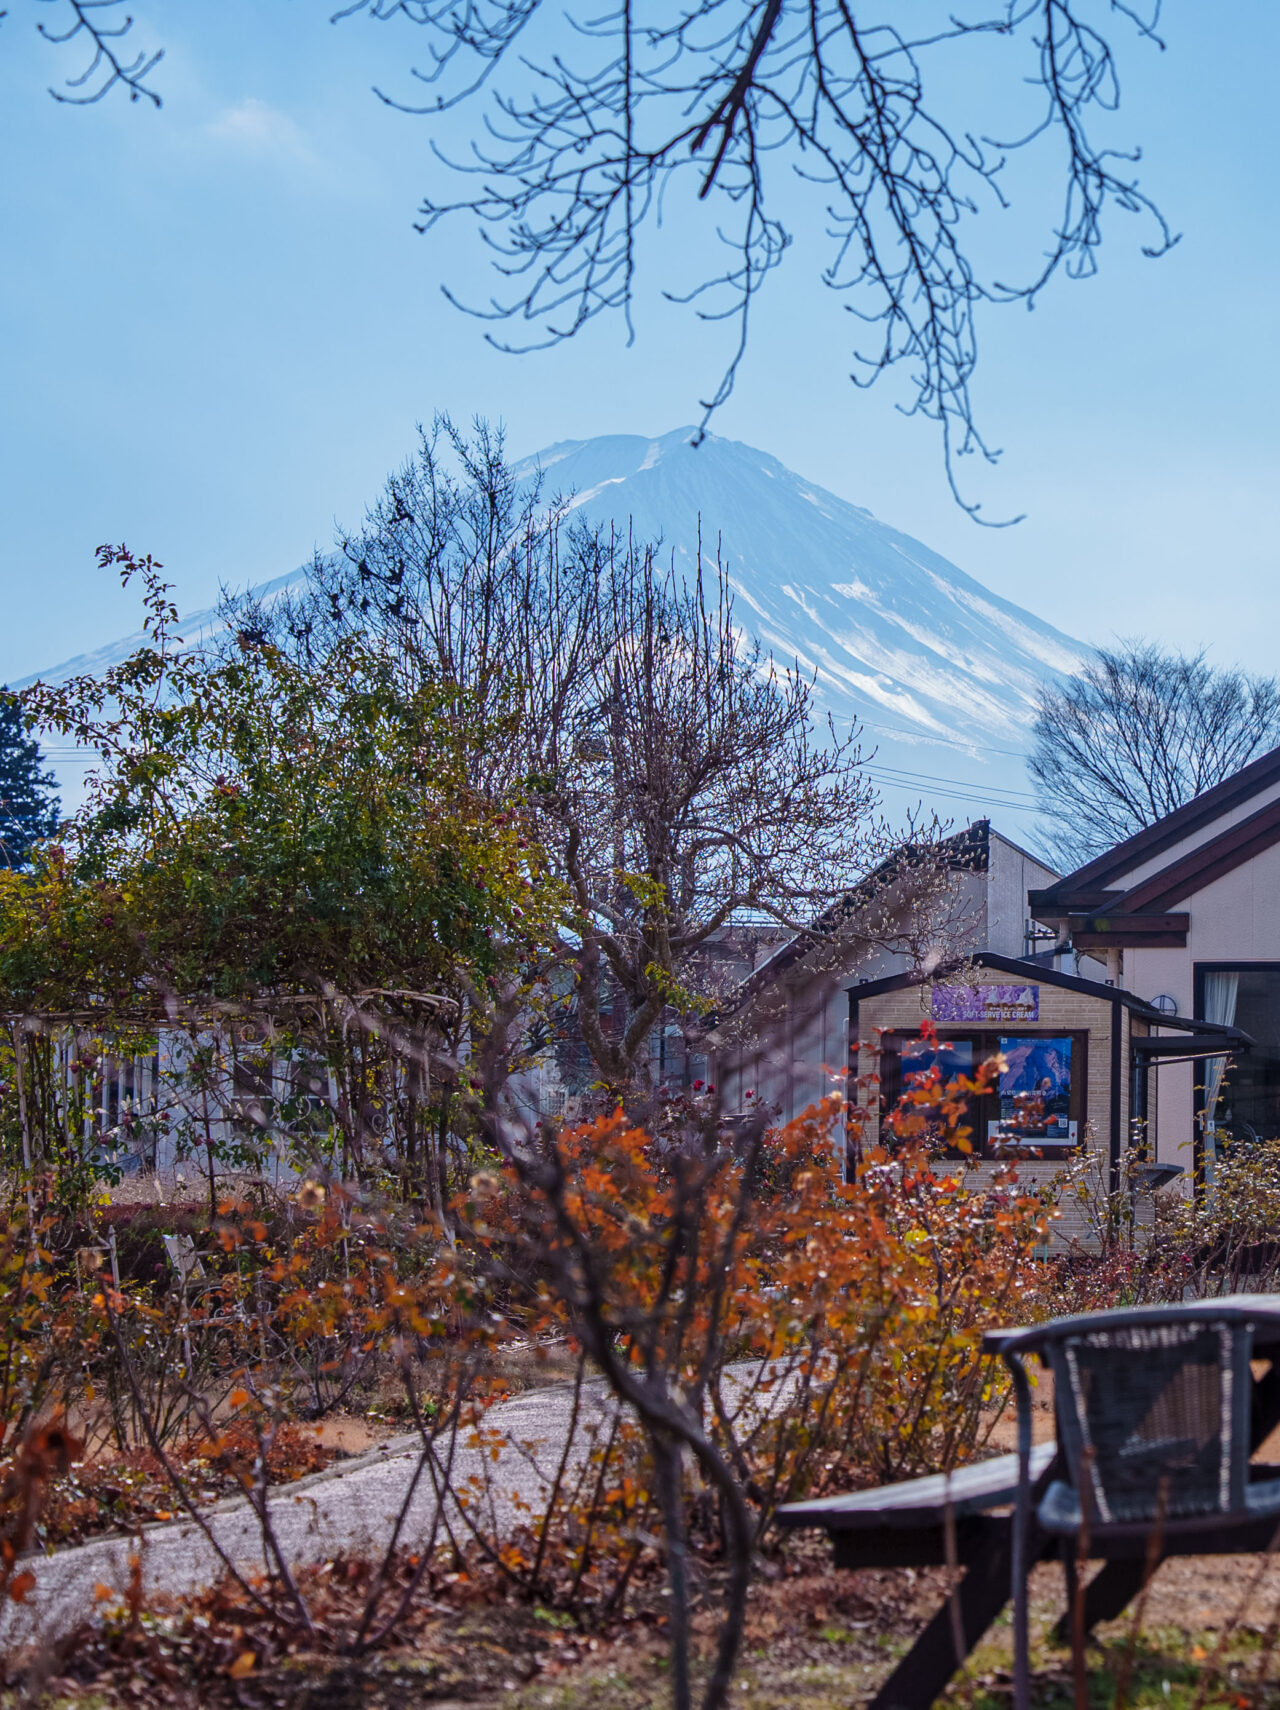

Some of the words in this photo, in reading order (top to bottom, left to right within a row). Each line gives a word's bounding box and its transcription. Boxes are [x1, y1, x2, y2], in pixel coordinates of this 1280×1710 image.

[962, 1010, 1001, 1019] SOFT-SERVE
[1001, 1010, 1012, 1019] ICE
[1012, 1010, 1035, 1019] CREAM
